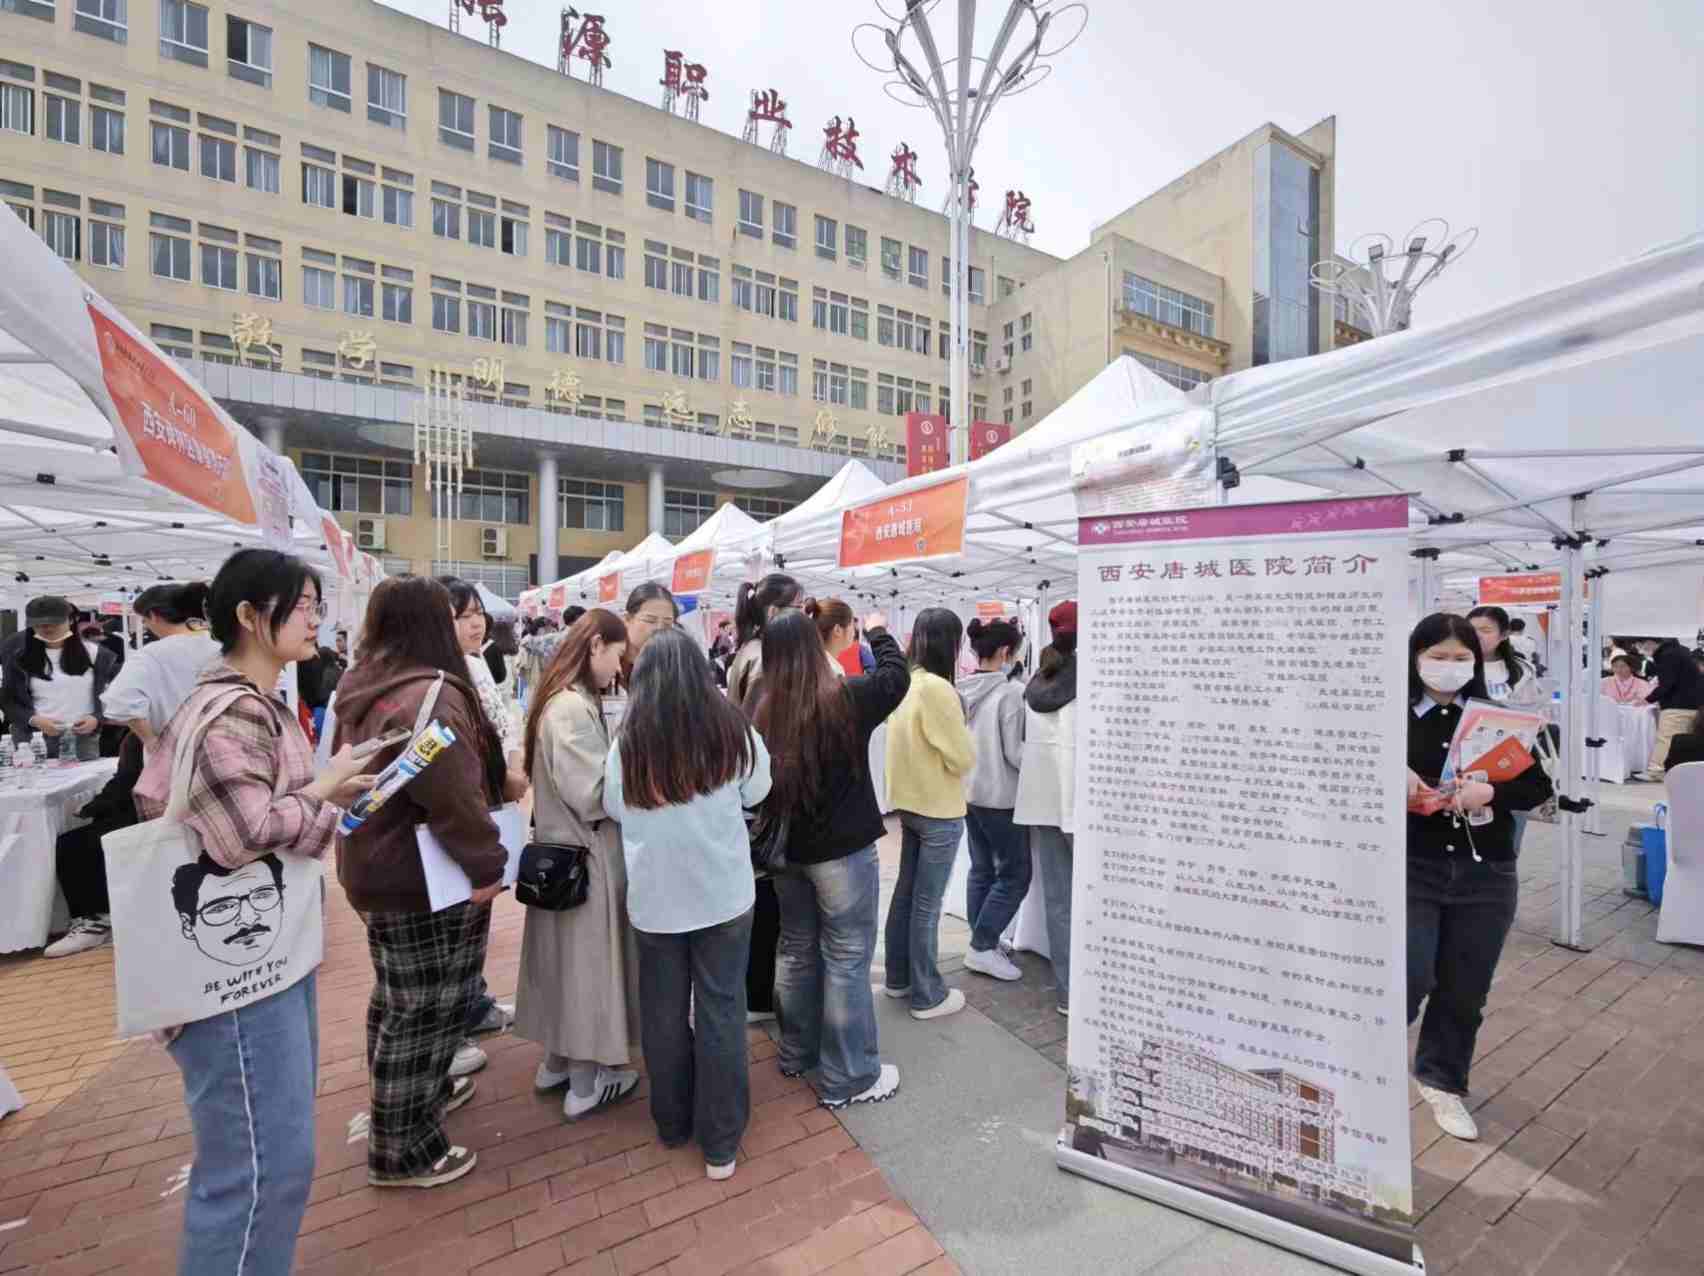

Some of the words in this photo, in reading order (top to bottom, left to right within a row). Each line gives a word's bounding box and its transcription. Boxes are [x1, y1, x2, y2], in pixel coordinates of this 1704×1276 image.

[1097, 553, 1379, 582] 西安唐城医院简介
[203, 980, 222, 994] BE
[266, 955, 288, 973] YOU
